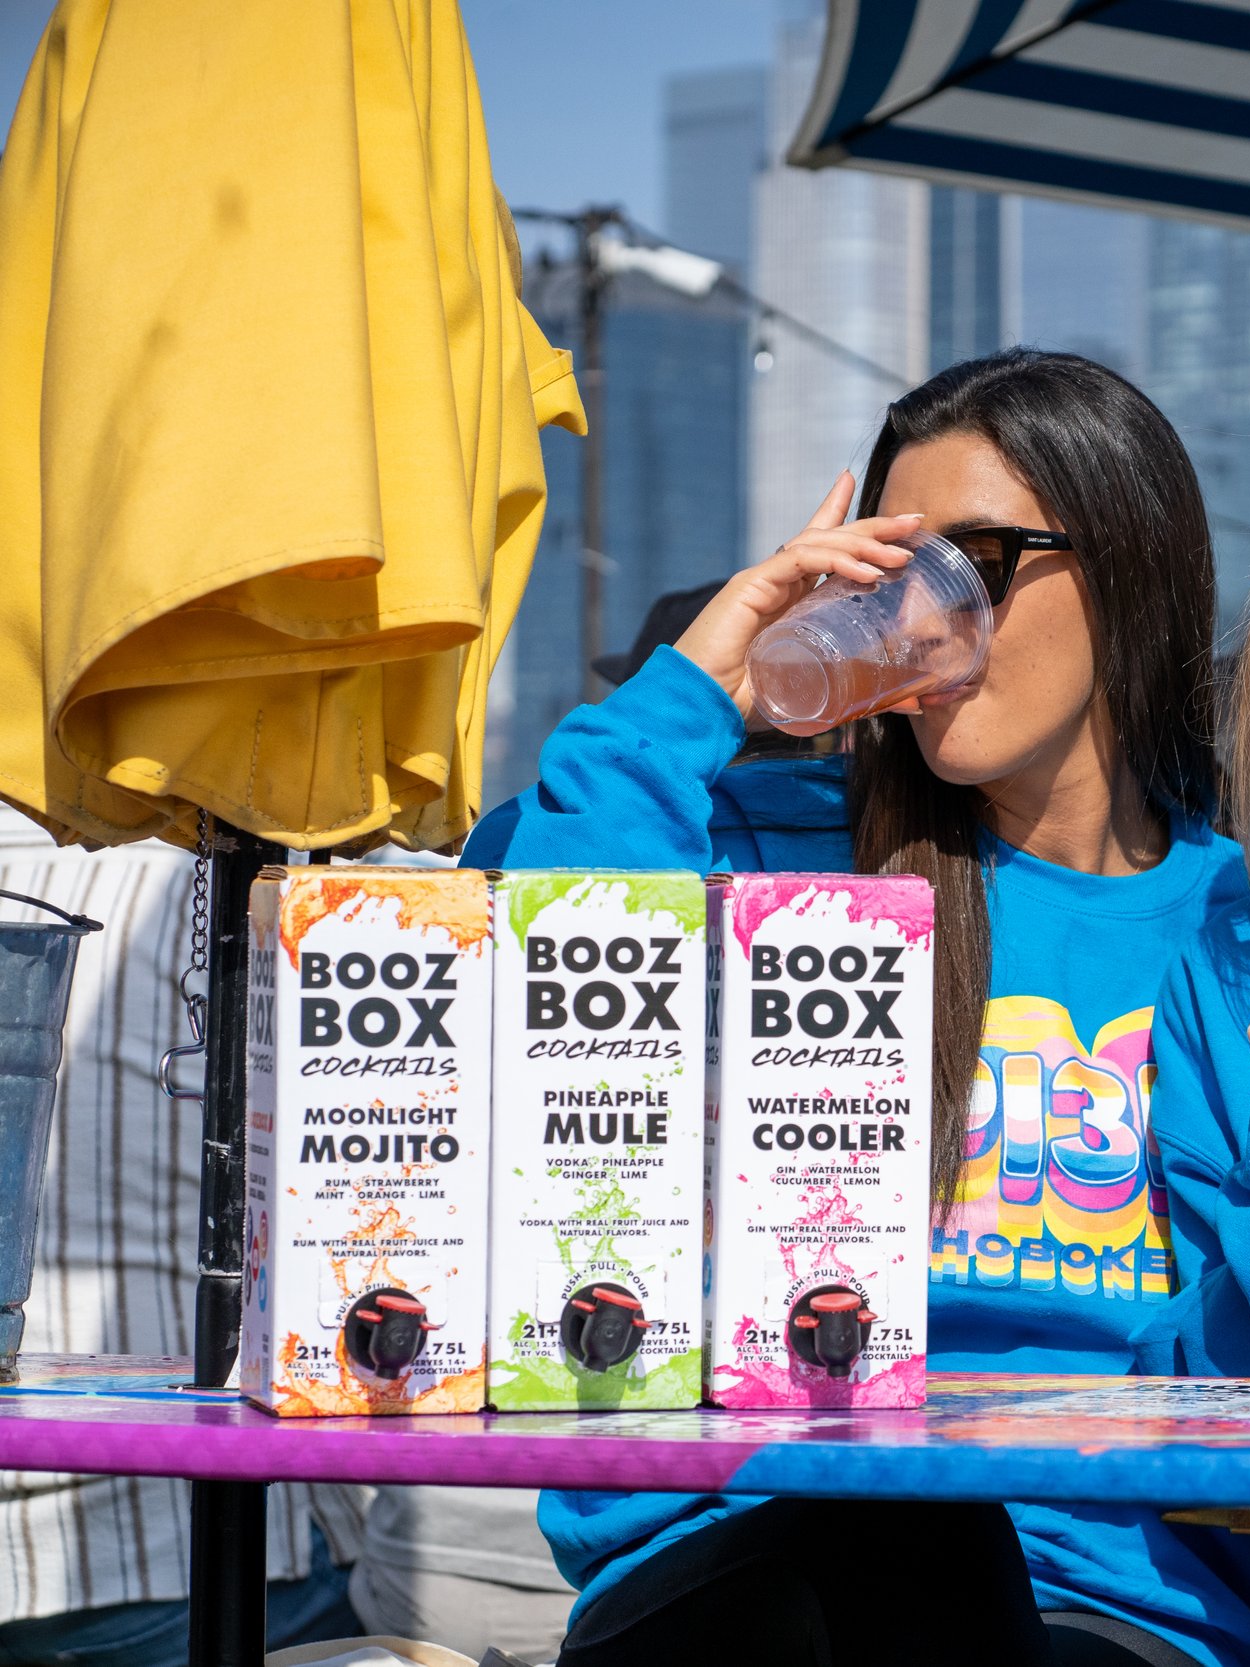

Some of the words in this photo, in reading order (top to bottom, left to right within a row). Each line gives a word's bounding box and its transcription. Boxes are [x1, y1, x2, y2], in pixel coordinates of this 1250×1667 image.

[527, 936, 683, 974] BOOZ
[301, 952, 458, 990] BOOZ
[751, 945, 905, 983] BOOZ
[527, 980, 682, 1031] BOX
[249, 994, 274, 1045] BOX
[751, 989, 904, 1039] BOX
[300, 997, 456, 1048] BOX
[527, 1038, 683, 1060] COCKTAILS
[751, 1046, 904, 1068] COCKTAILS
[301, 1055, 458, 1078] COCKTAILS
[543, 1090, 669, 1107] PINEAPPLE
[748, 1098, 911, 1115] WATERMELON
[303, 1108, 458, 1125] MOONLIGHT
[543, 1113, 668, 1145] MULE
[753, 1123, 906, 1152] COOLER
[300, 1134, 460, 1164] MOJITO
[546, 1158, 588, 1167] VODKA
[602, 1158, 665, 1167] PINEAPPLE
[776, 1166, 796, 1174] GIN
[808, 1166, 880, 1174] WATERMELON
[325, 1178, 351, 1187] RUM
[363, 1178, 440, 1187] STRAWBERRY
[562, 1171, 608, 1180] GINGER
[621, 1170, 648, 1179] LIME
[776, 1177, 832, 1186] CUCUMBER
[844, 1177, 881, 1186] LEMON
[315, 1191, 345, 1200] MINT
[357, 1191, 406, 1200] ORANGE
[419, 1190, 446, 1199] LIME
[519, 1219, 554, 1227] VODKA
[558, 1219, 583, 1227] WITH
[586, 1219, 609, 1227] REAL
[748, 1225, 766, 1233] GIN
[769, 1225, 795, 1233] WITH
[799, 1225, 823, 1233] REAL
[826, 1225, 853, 1233] FRUIT
[856, 1225, 882, 1233] JUICE
[885, 1225, 906, 1233] AND
[560, 1229, 602, 1237] NATURAL
[606, 1229, 651, 1237] FLAVORS.
[780, 1236, 825, 1244] NATURAL
[293, 1239, 317, 1247] RUM
[321, 1239, 347, 1247] WITH
[351, 1239, 376, 1247] REAL
[412, 1238, 438, 1246] JUICE
[442, 1238, 464, 1246] AND
[332, 1250, 378, 1258] NATURAL
[382, 1249, 430, 1257] FLAVORS.
[931, 1226, 1176, 1292] HOBOKE
[561, 1273, 582, 1300] PUSH
[590, 1261, 617, 1272] PULL
[626, 1270, 649, 1299] POUR
[783, 1279, 805, 1306] PUSH
[813, 1269, 840, 1279] PULL
[523, 1324, 558, 1339] 21+
[651, 1322, 690, 1335] .75L
[873, 1329, 913, 1341] .75L
[674, 1338, 691, 1346] 14+
[746, 1330, 780, 1344] 21+
[297, 1345, 332, 1360] 21+
[425, 1342, 466, 1355] .75L
[640, 1347, 688, 1355] COCKTAILS
